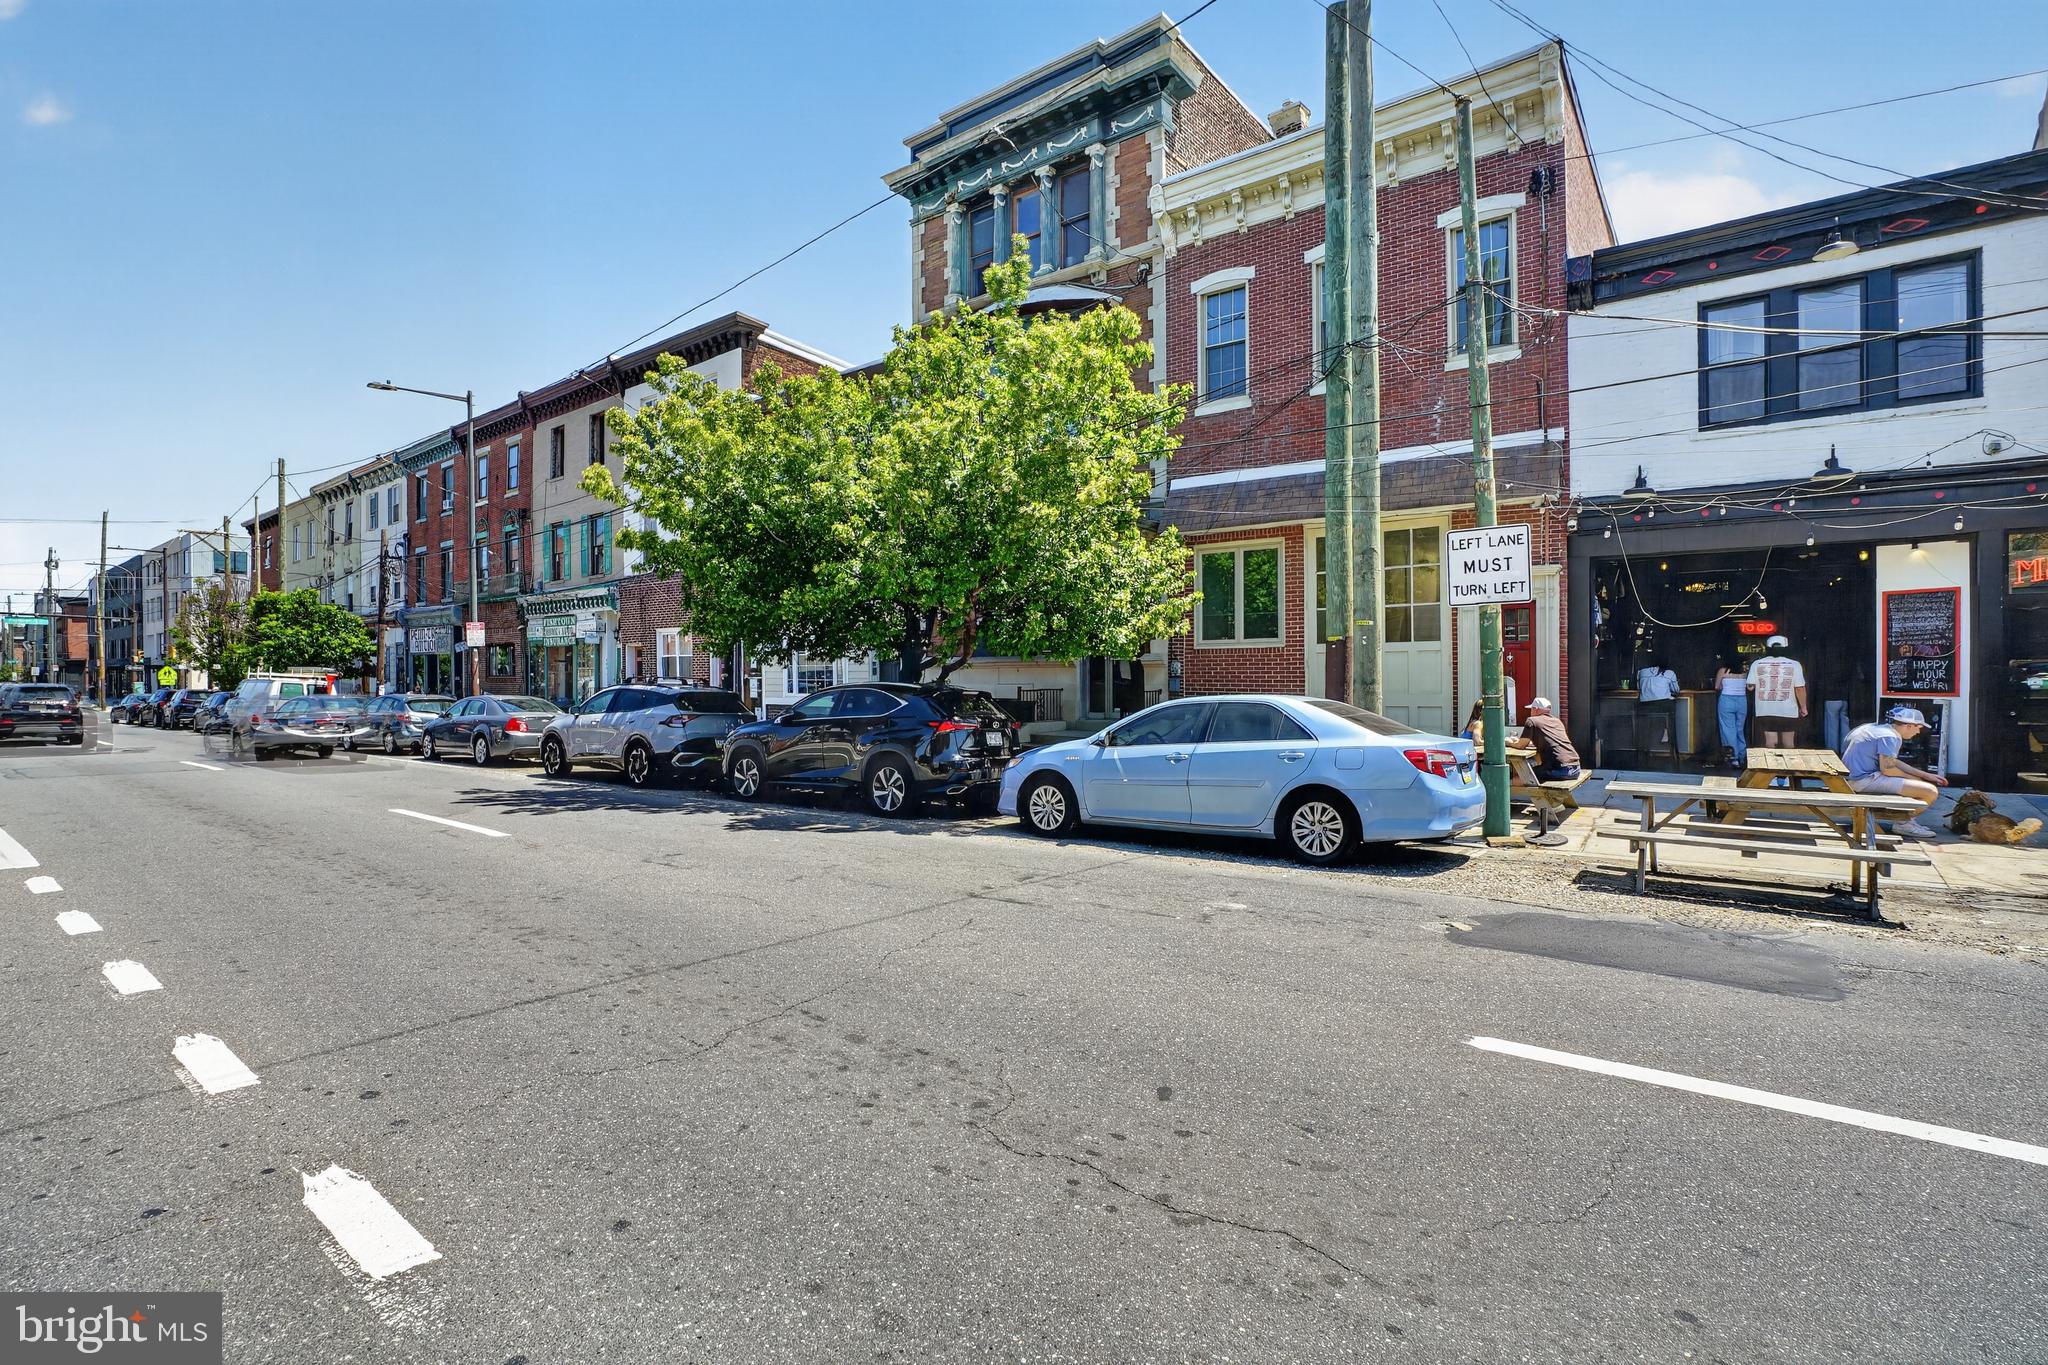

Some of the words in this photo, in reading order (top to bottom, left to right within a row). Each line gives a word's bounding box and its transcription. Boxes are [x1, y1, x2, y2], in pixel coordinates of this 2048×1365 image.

[1451, 537, 1482, 551] LEFT
[1488, 533, 1525, 548] LANE
[1463, 556, 1513, 574] MUST
[1452, 583, 1487, 597] TURN
[1493, 580, 1526, 594] LEFT
[1739, 623, 1754, 632] TO
[1756, 623, 1774, 632] GO
[1913, 660, 1949, 670] HAPPY
[1916, 669, 1946, 679] HOUR
